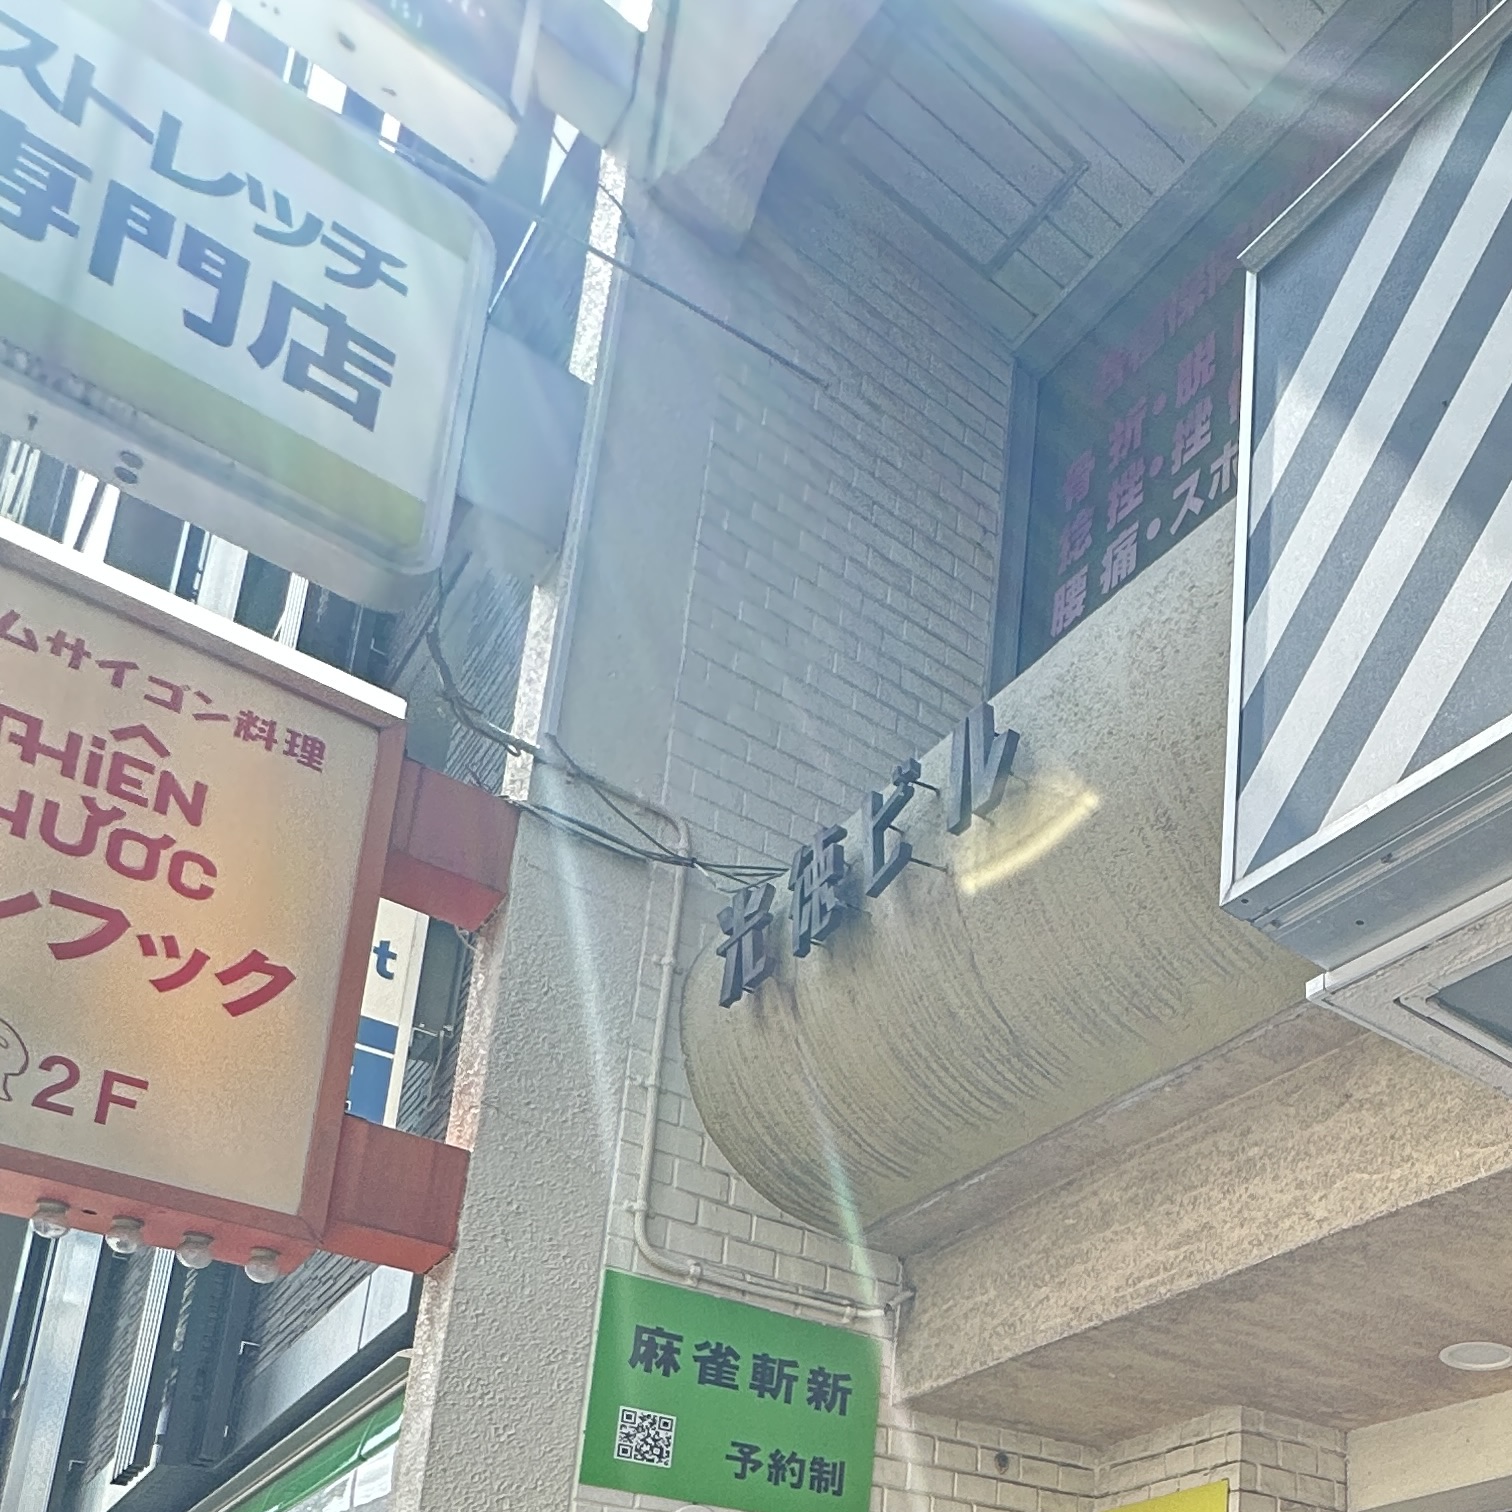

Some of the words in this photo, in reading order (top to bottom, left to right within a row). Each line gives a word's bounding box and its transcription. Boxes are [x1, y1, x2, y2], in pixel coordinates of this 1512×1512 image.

[0, 8, 408, 297] ストレッチ
[0, 889, 297, 1018] フック
[32, 1055, 150, 1126] 2F
[628, 1325, 853, 1418] 麻雀斬新
[725, 1440, 846, 1498] 予約制
